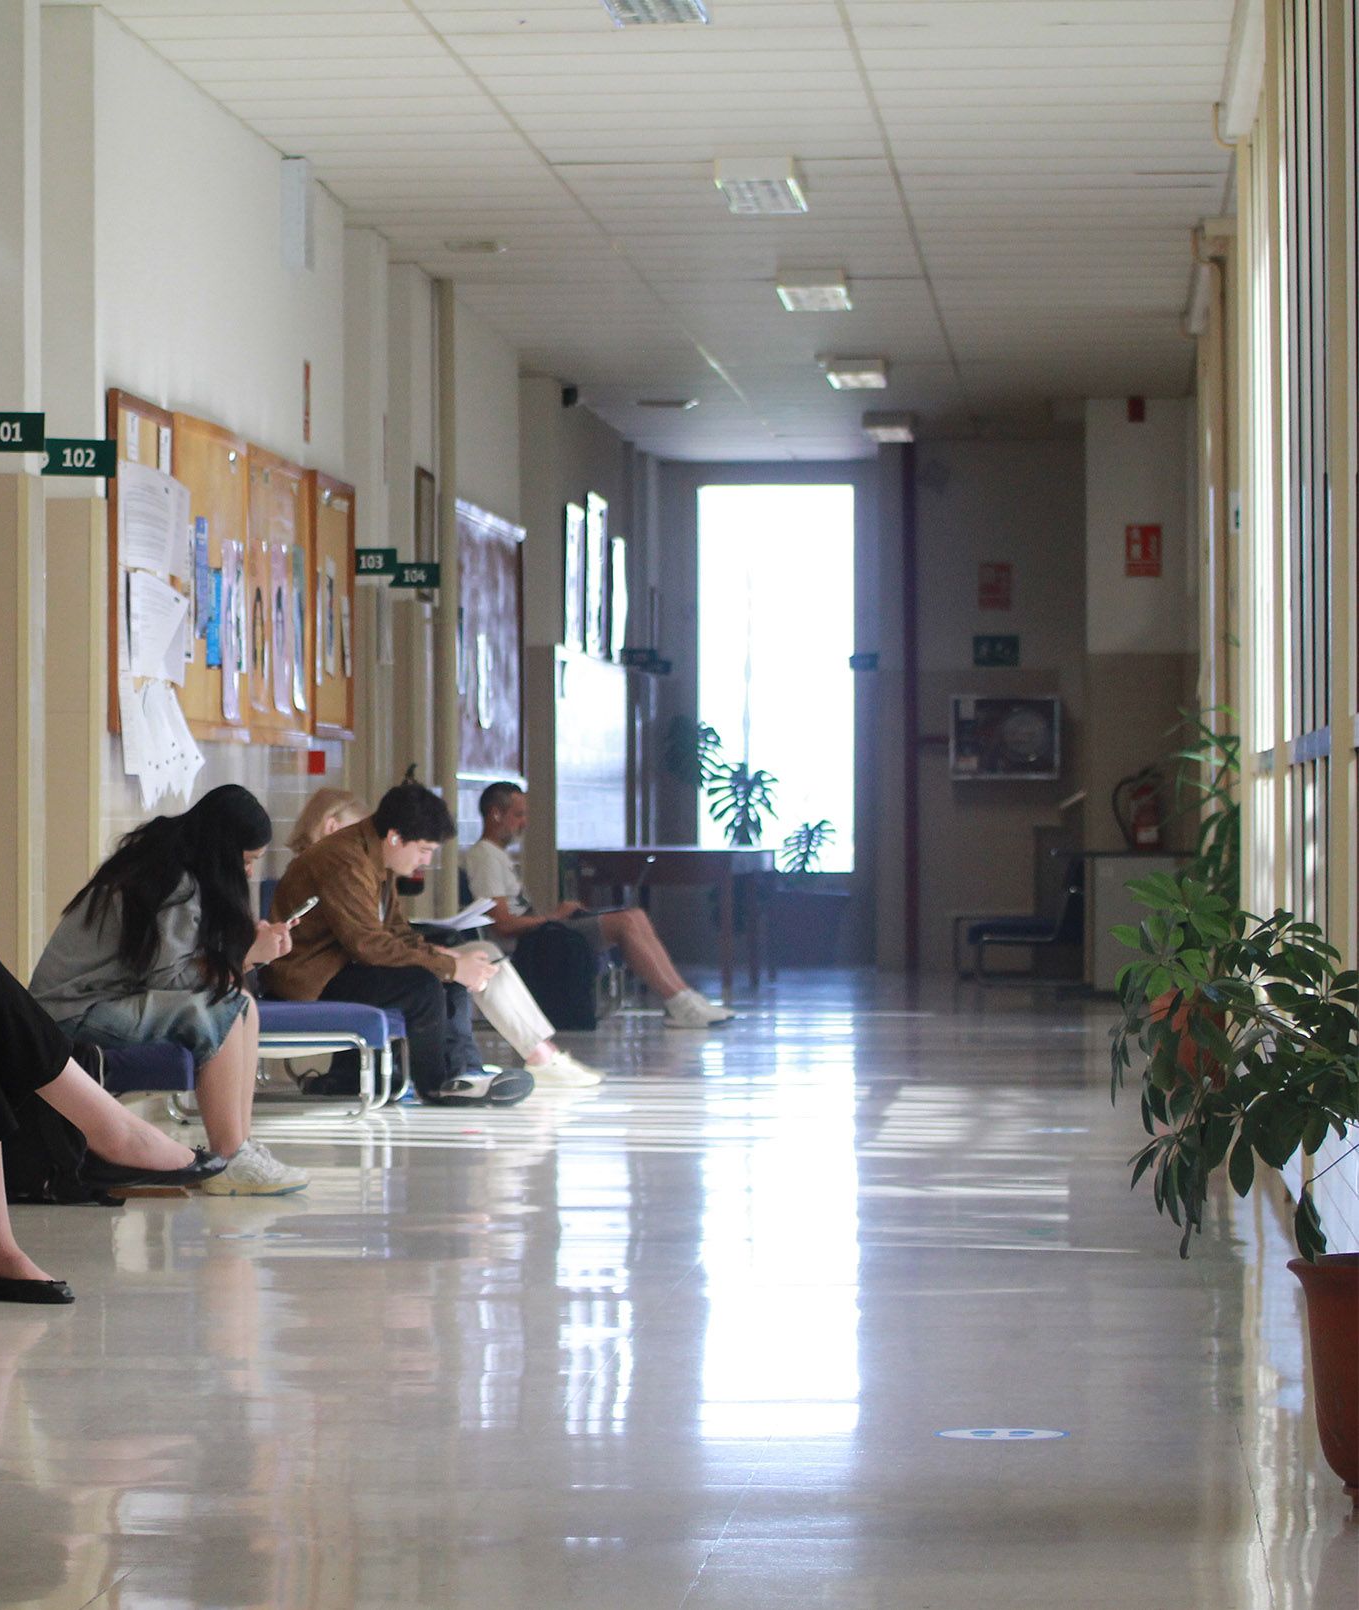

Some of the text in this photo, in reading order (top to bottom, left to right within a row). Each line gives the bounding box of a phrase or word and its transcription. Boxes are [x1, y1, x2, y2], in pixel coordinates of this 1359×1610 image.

[62, 448, 96, 467] 102
[360, 555, 383, 569] 103
[403, 569, 427, 583] 104
